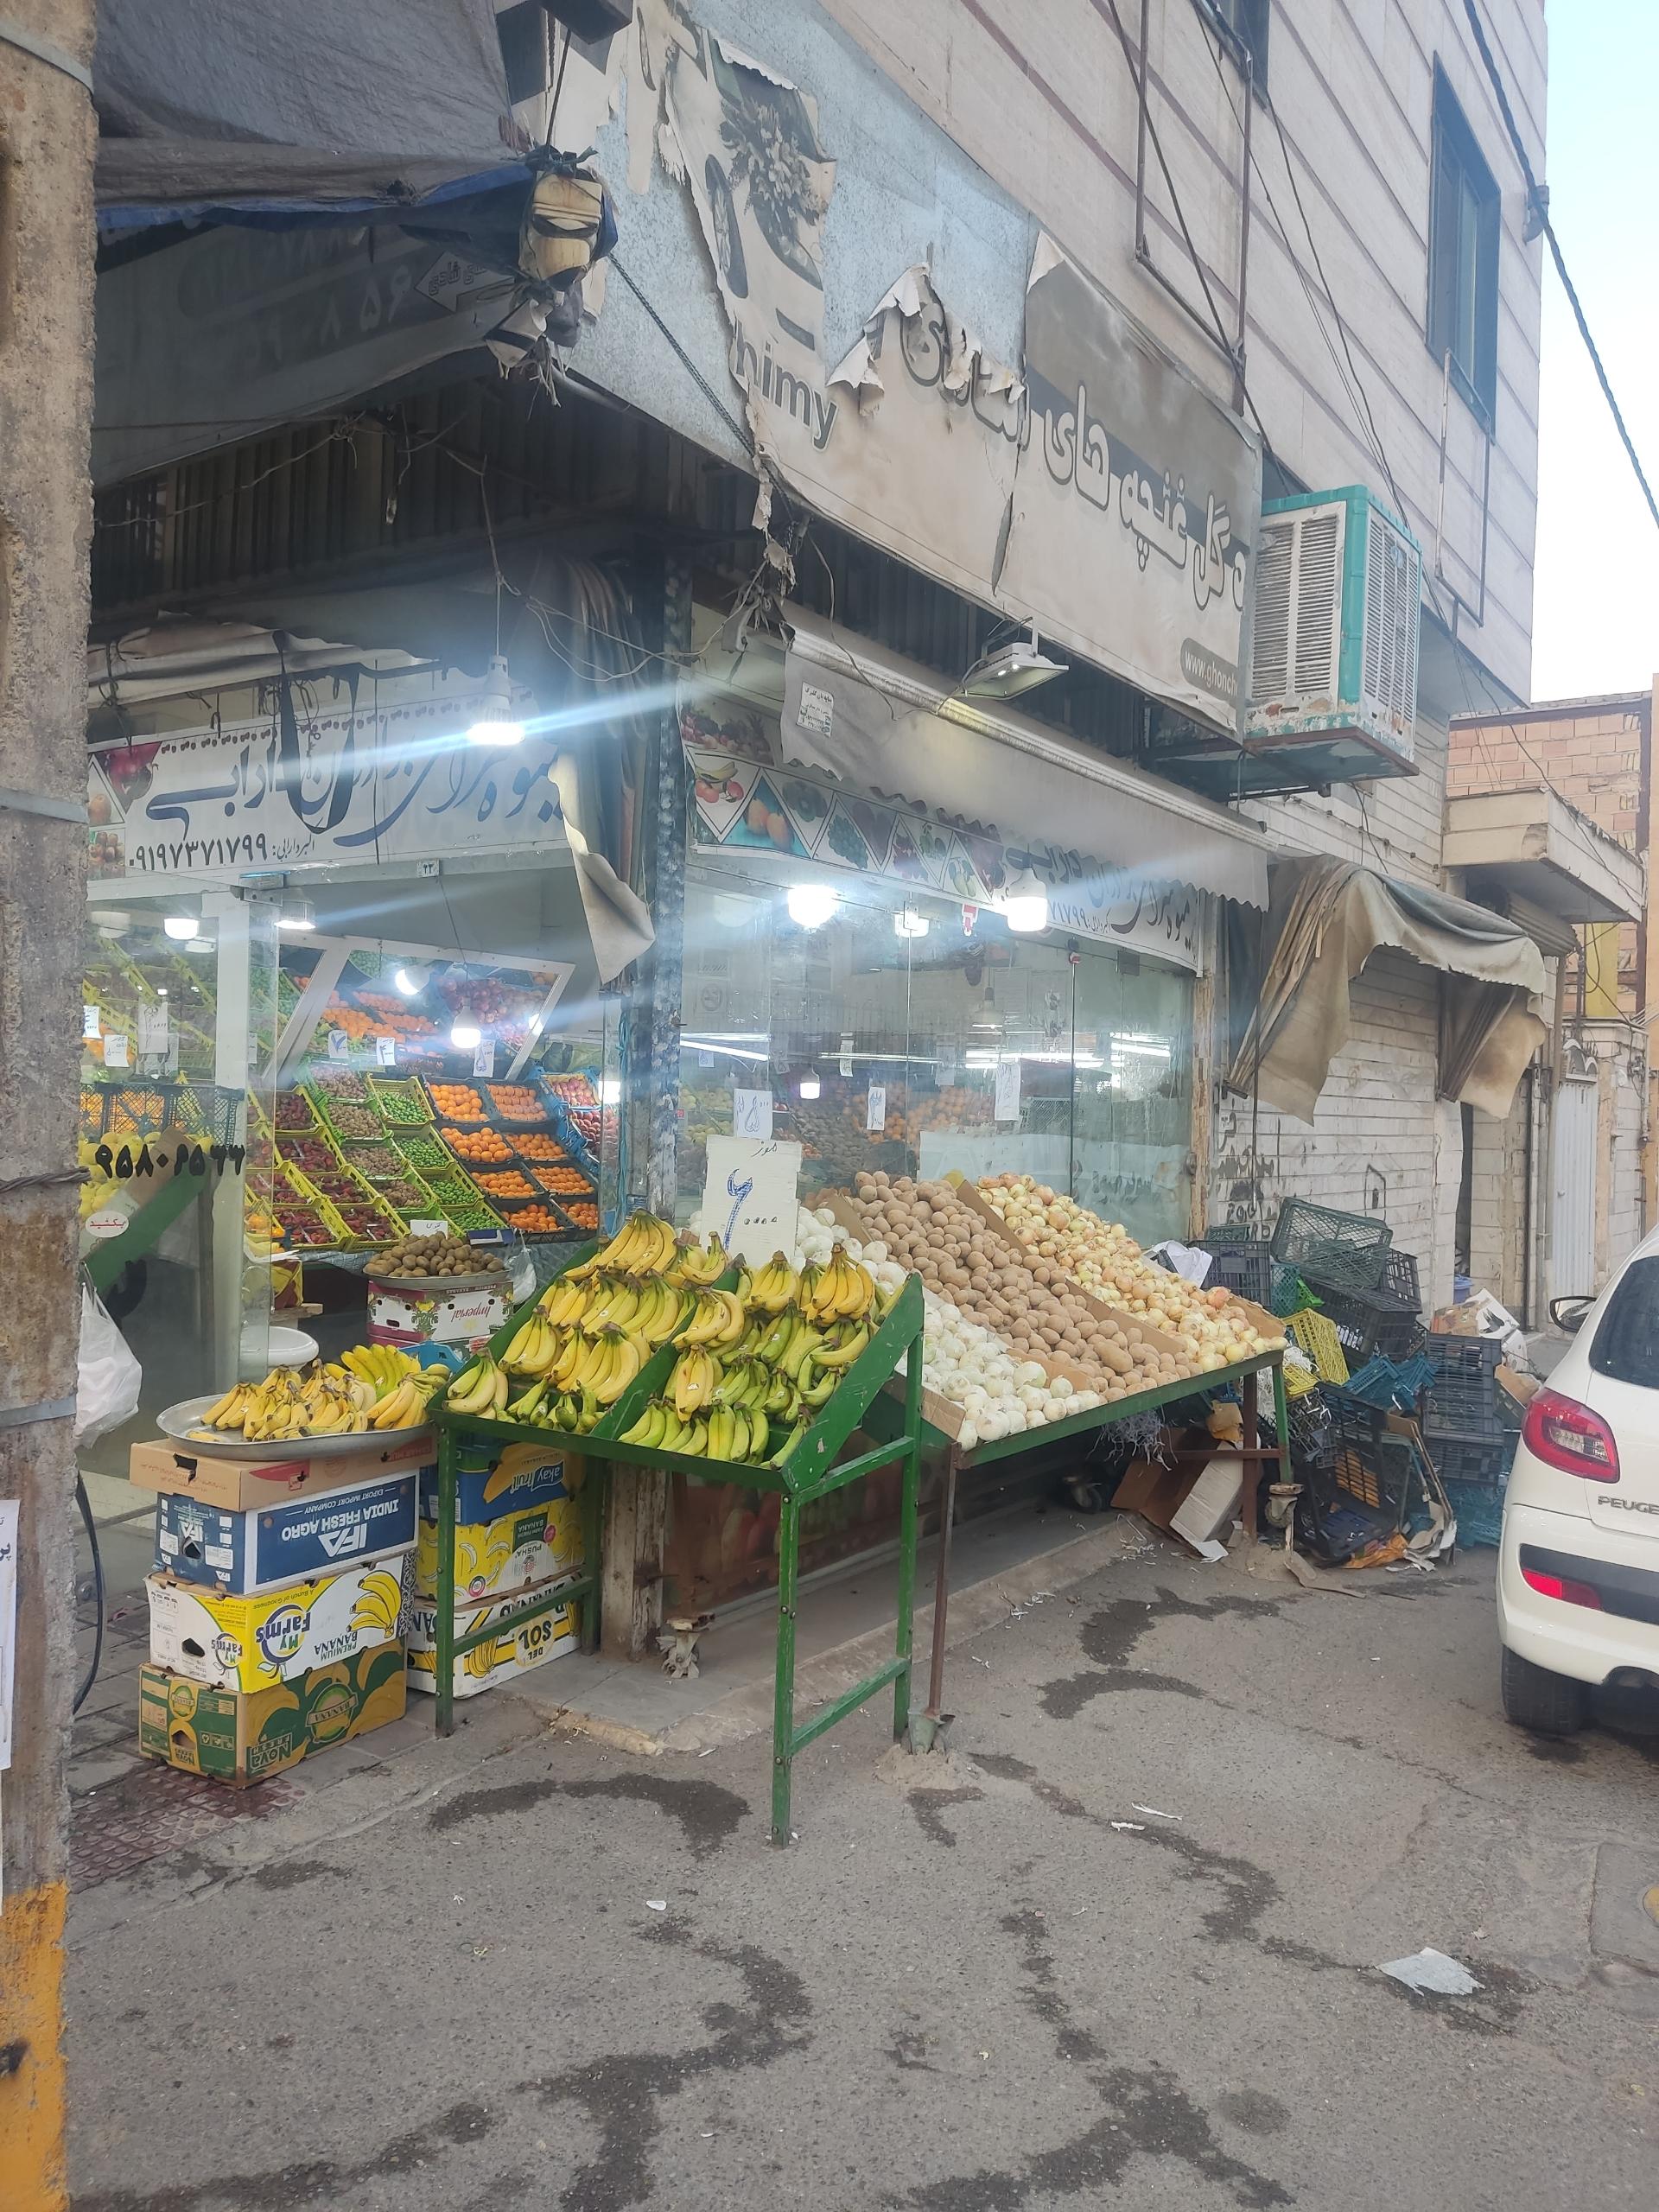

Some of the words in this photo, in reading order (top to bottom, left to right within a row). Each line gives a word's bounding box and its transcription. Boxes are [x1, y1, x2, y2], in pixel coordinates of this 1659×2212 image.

[1043, 380, 1110, 512] های
[1119, 468, 1188, 572] غنچه
[1193, 491, 1231, 611] گل
[130, 832, 268, 871] ۰۹۱۹۷۳۷۱۷۹۹
[451, 1302, 491, 1323] Imperial
[537, 1466, 561, 1482] akay
[338, 1494, 360, 1507] IMPORT
[361, 1488, 384, 1502] EXPORT
[304, 1499, 337, 1514] COMPANY
[364, 1498, 399, 1520] INDIA
[1598, 1496, 1659, 1516] PEUGE
[281, 1519, 320, 1542] AGRO
[321, 1507, 361, 1534] FRESH
[518, 1518, 544, 1535] BANANA
[317, 1522, 367, 1557] IFA
[517, 1543, 543, 1557] PUSHA
[283, 1594, 290, 1604] of
[290, 1590, 309, 1600] Bunch
[255, 1611, 311, 1643] Farms
[518, 1619, 552, 1650] SOL
[314, 1630, 359, 1656] BANANA
[320, 1642, 357, 1662] PREMIUM
[527, 1646, 543, 1661] DEL
